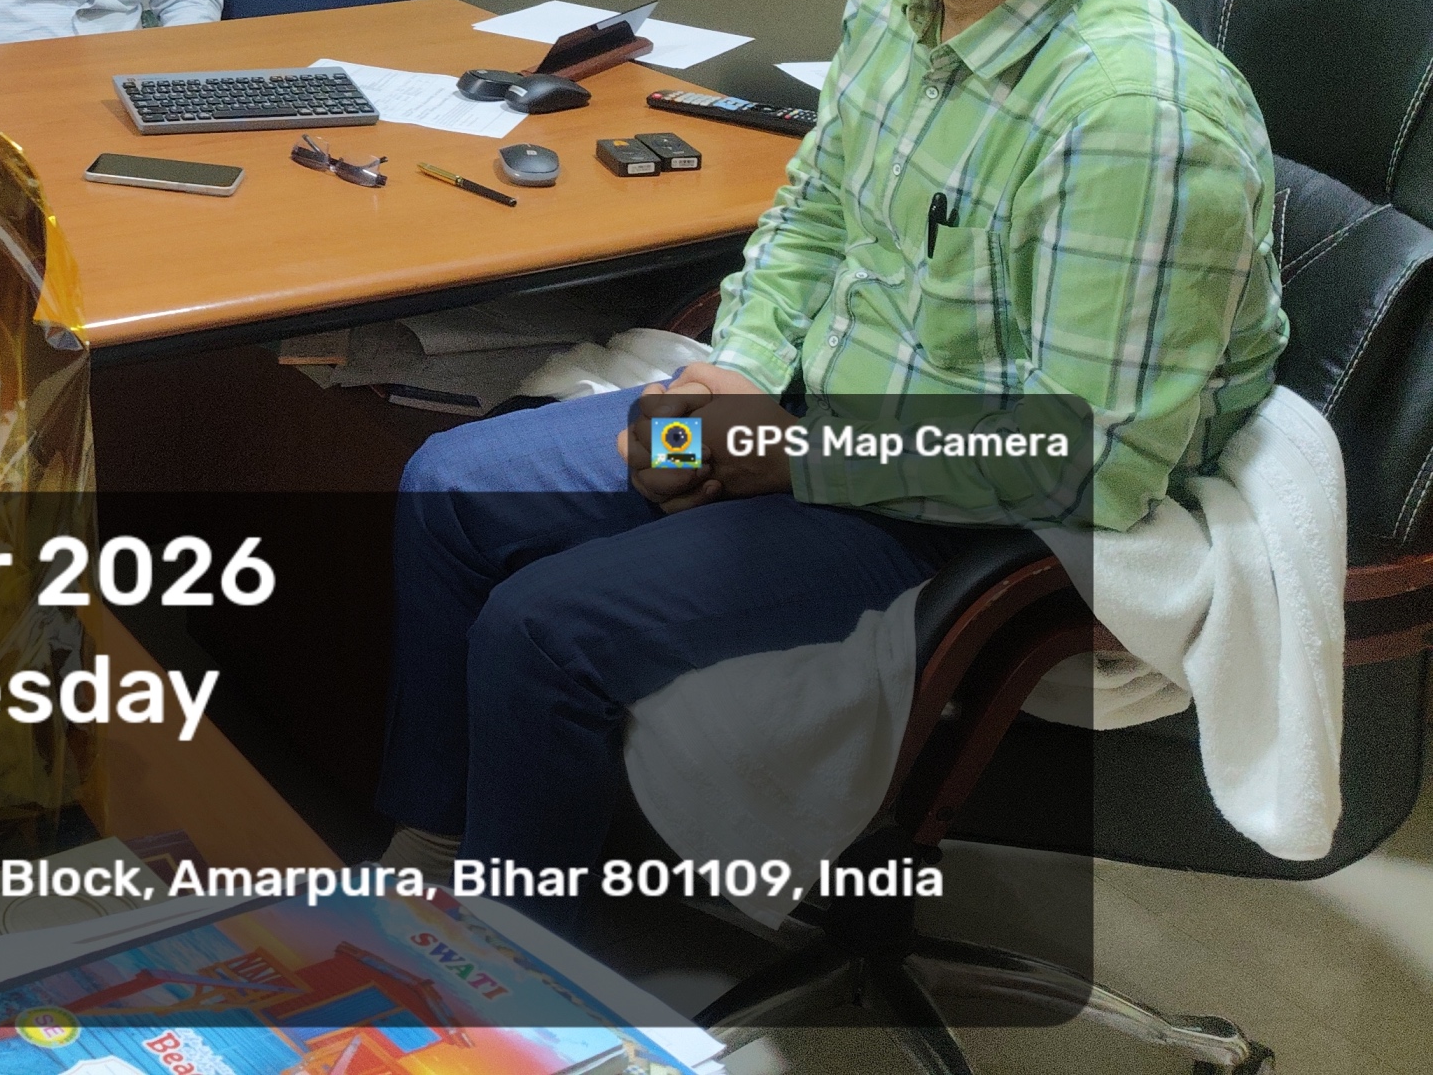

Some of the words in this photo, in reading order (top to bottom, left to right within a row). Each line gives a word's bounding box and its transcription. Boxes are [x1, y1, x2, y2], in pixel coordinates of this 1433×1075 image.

[410, 932, 510, 1000] SWATI
[34, 1014, 66, 1038] SE
[146, 1032, 200, 1075] Bea
